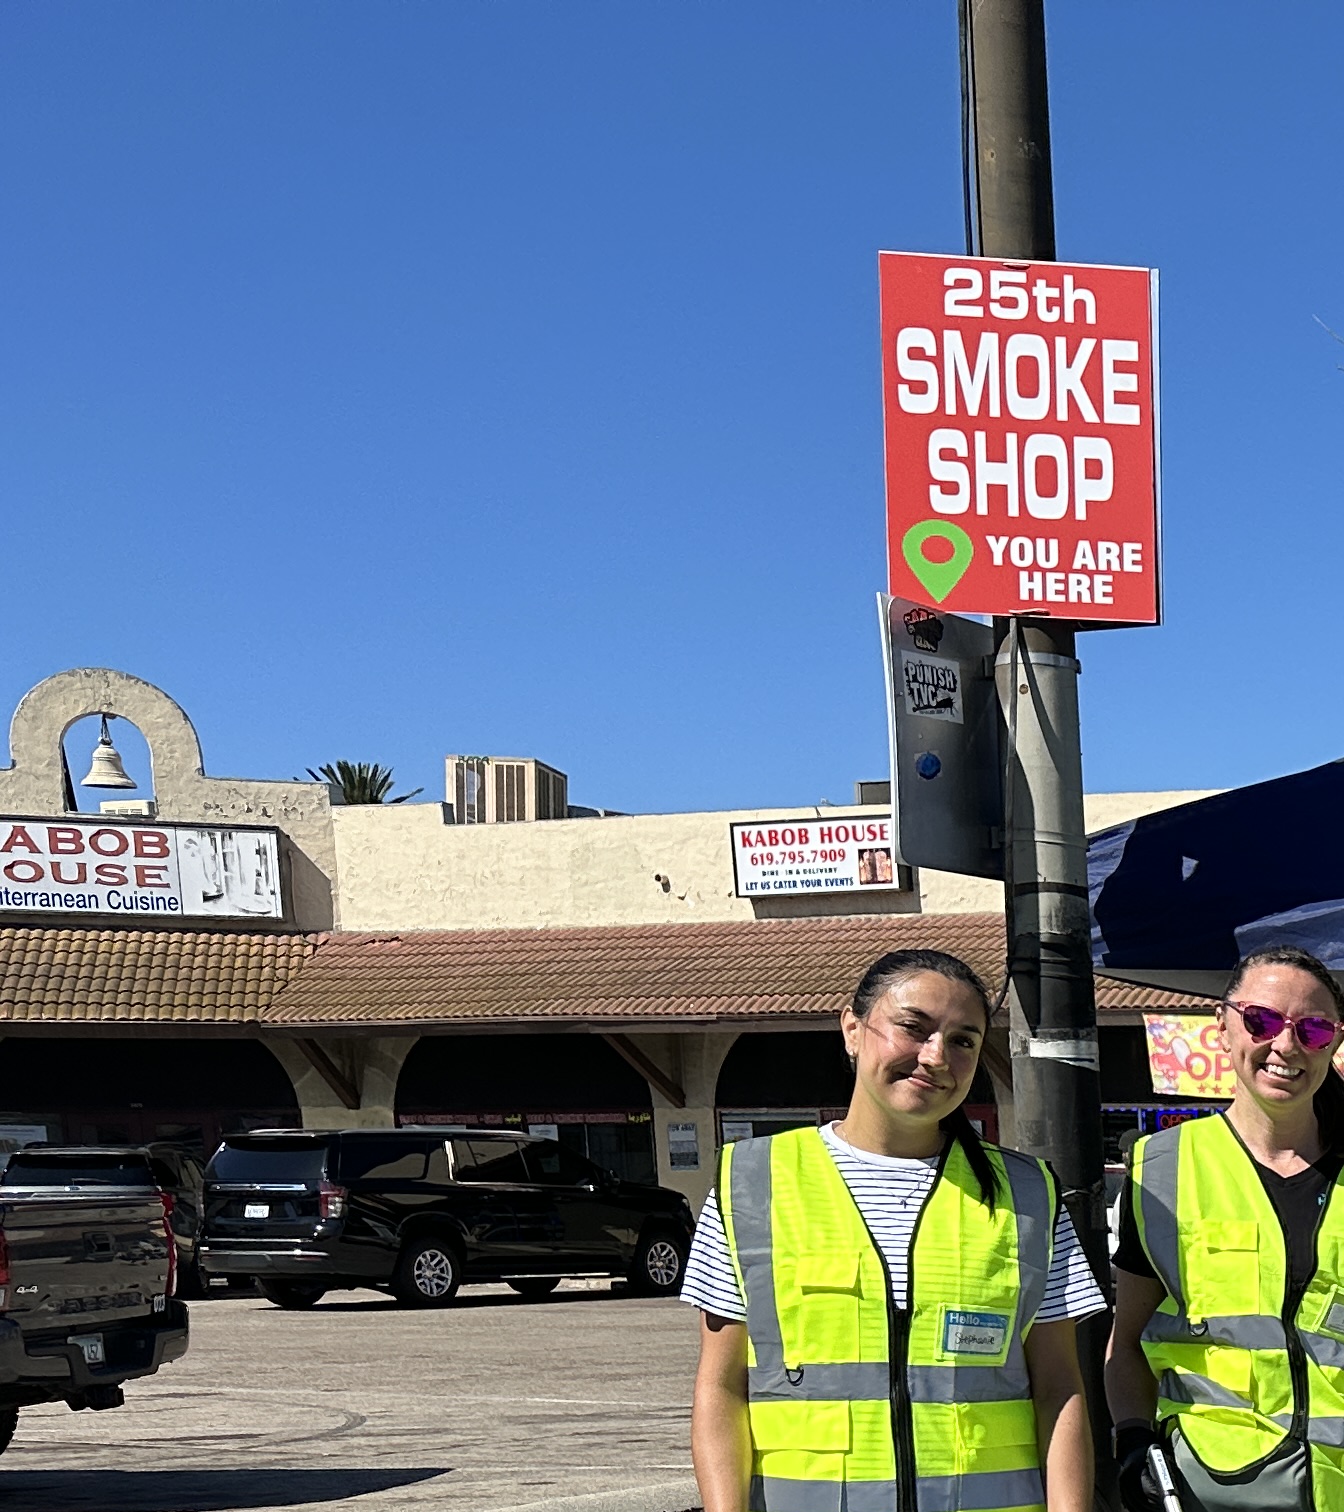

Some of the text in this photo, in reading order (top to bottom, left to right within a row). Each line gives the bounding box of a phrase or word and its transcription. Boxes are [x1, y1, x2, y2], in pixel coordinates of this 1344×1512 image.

[943, 267, 1097, 325] 25th
[896, 327, 1141, 426] SMOKE
[927, 428, 1114, 521] SHOP
[985, 534, 1142, 572] YOU ARE
[1019, 571, 1114, 604] HERE
[0, 825, 171, 859] ABOB
[740, 823, 889, 849] KABOB HOUSE
[750, 848, 846, 866] 619.795.7909
[3, 859, 172, 888] OUSE
[745, 877, 854, 891] LET US CATER YOUR EVENTS
[106, 889, 180, 912] Cuisine
[949, 1312, 980, 1325] Hello
